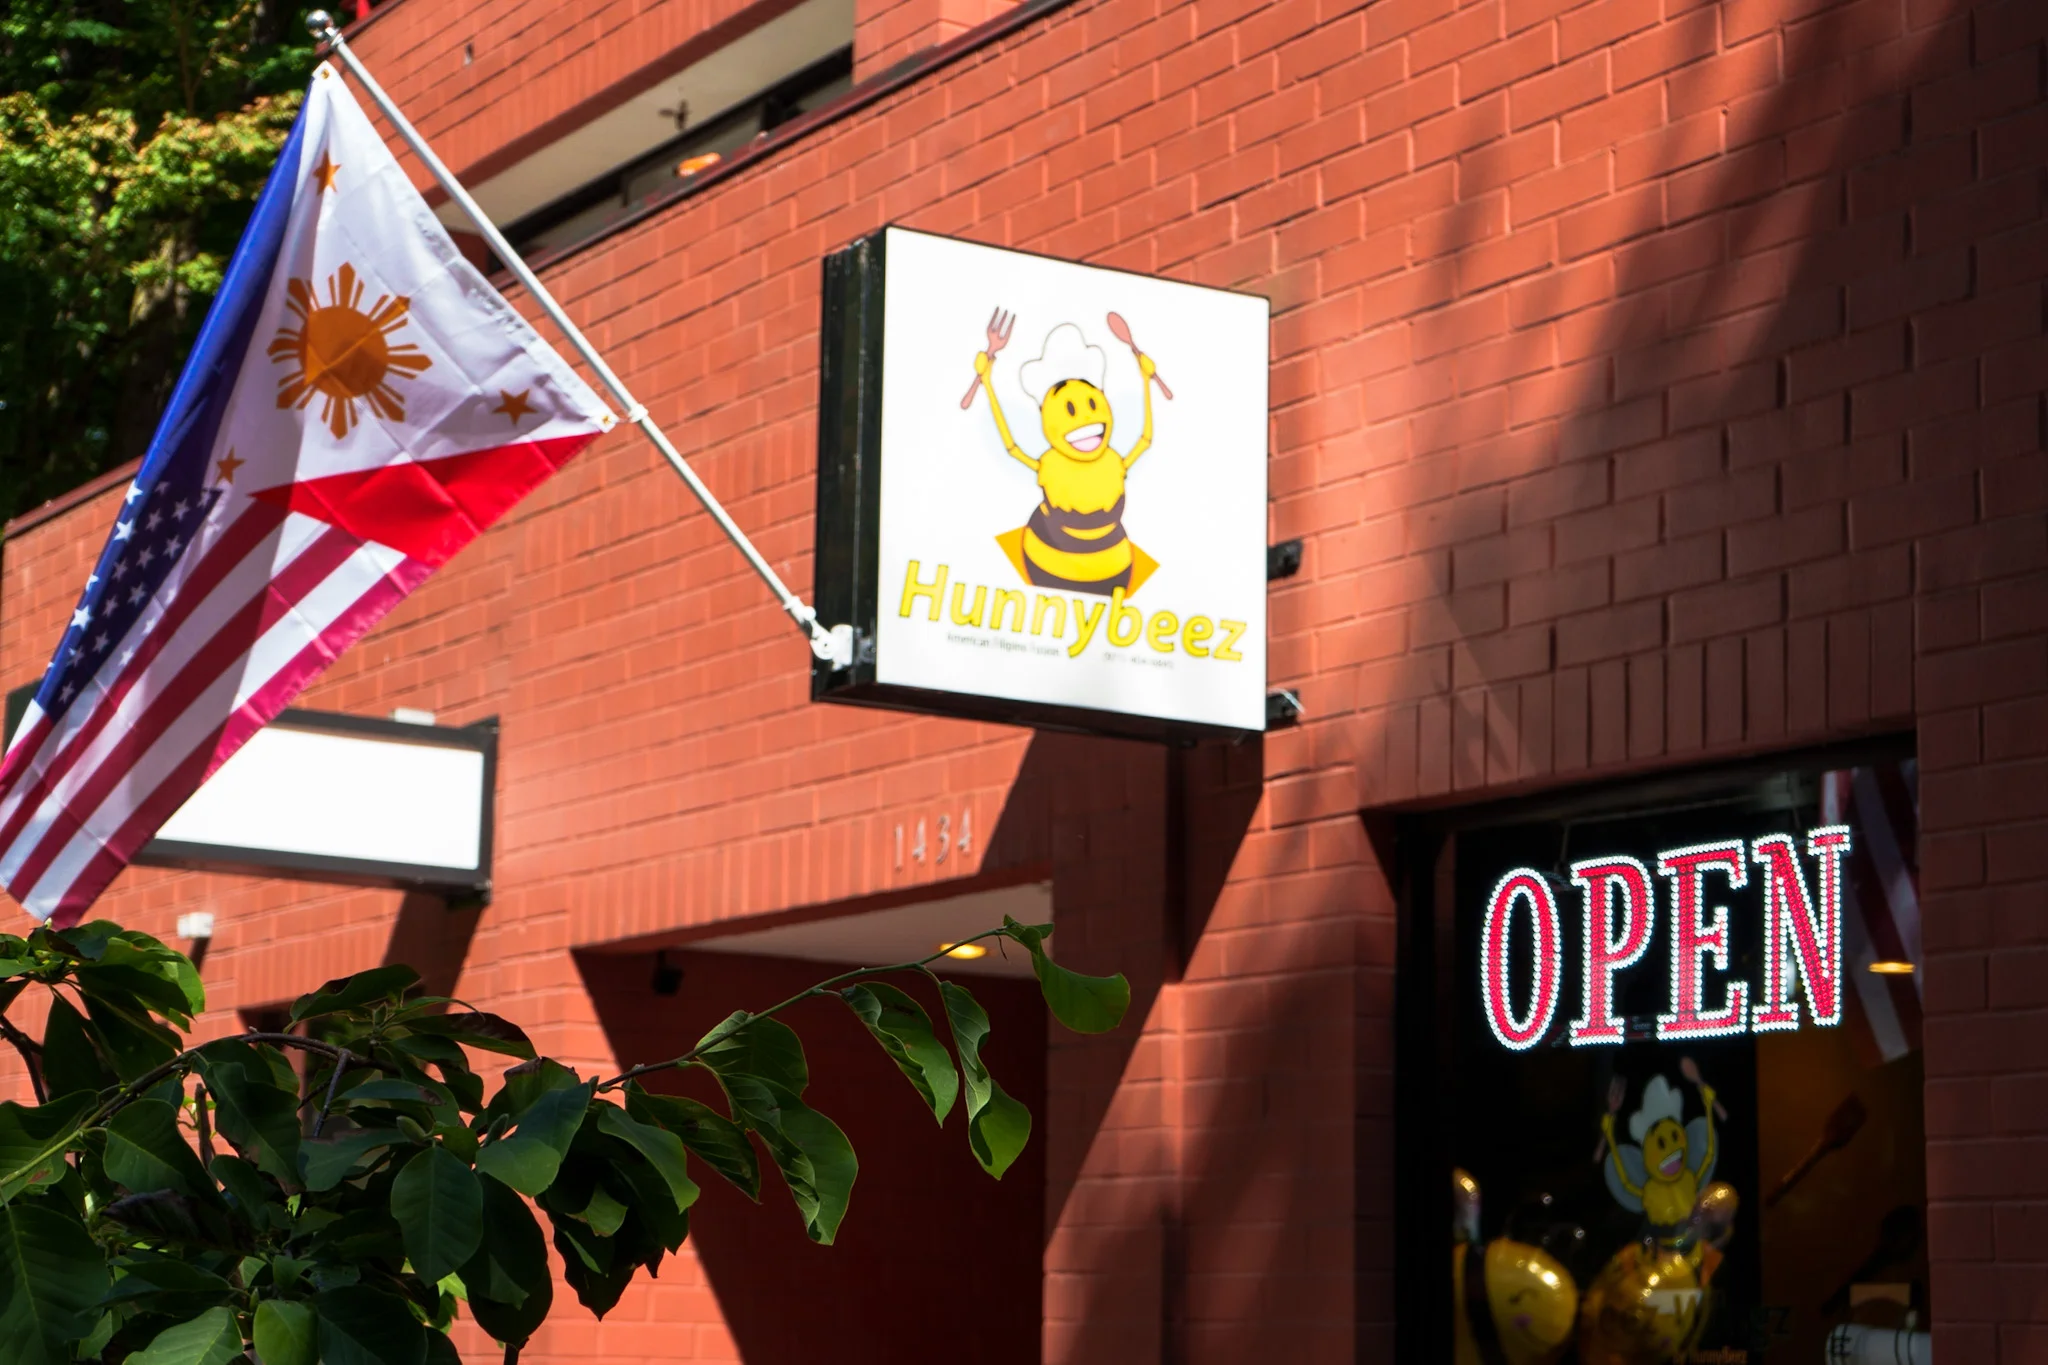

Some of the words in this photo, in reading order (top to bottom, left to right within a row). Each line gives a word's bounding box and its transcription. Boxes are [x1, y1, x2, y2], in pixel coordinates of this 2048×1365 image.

[898, 559, 1247, 662] Hunnybeez
[894, 806, 972, 873] 1434
[1480, 825, 1852, 1051] OPEN
